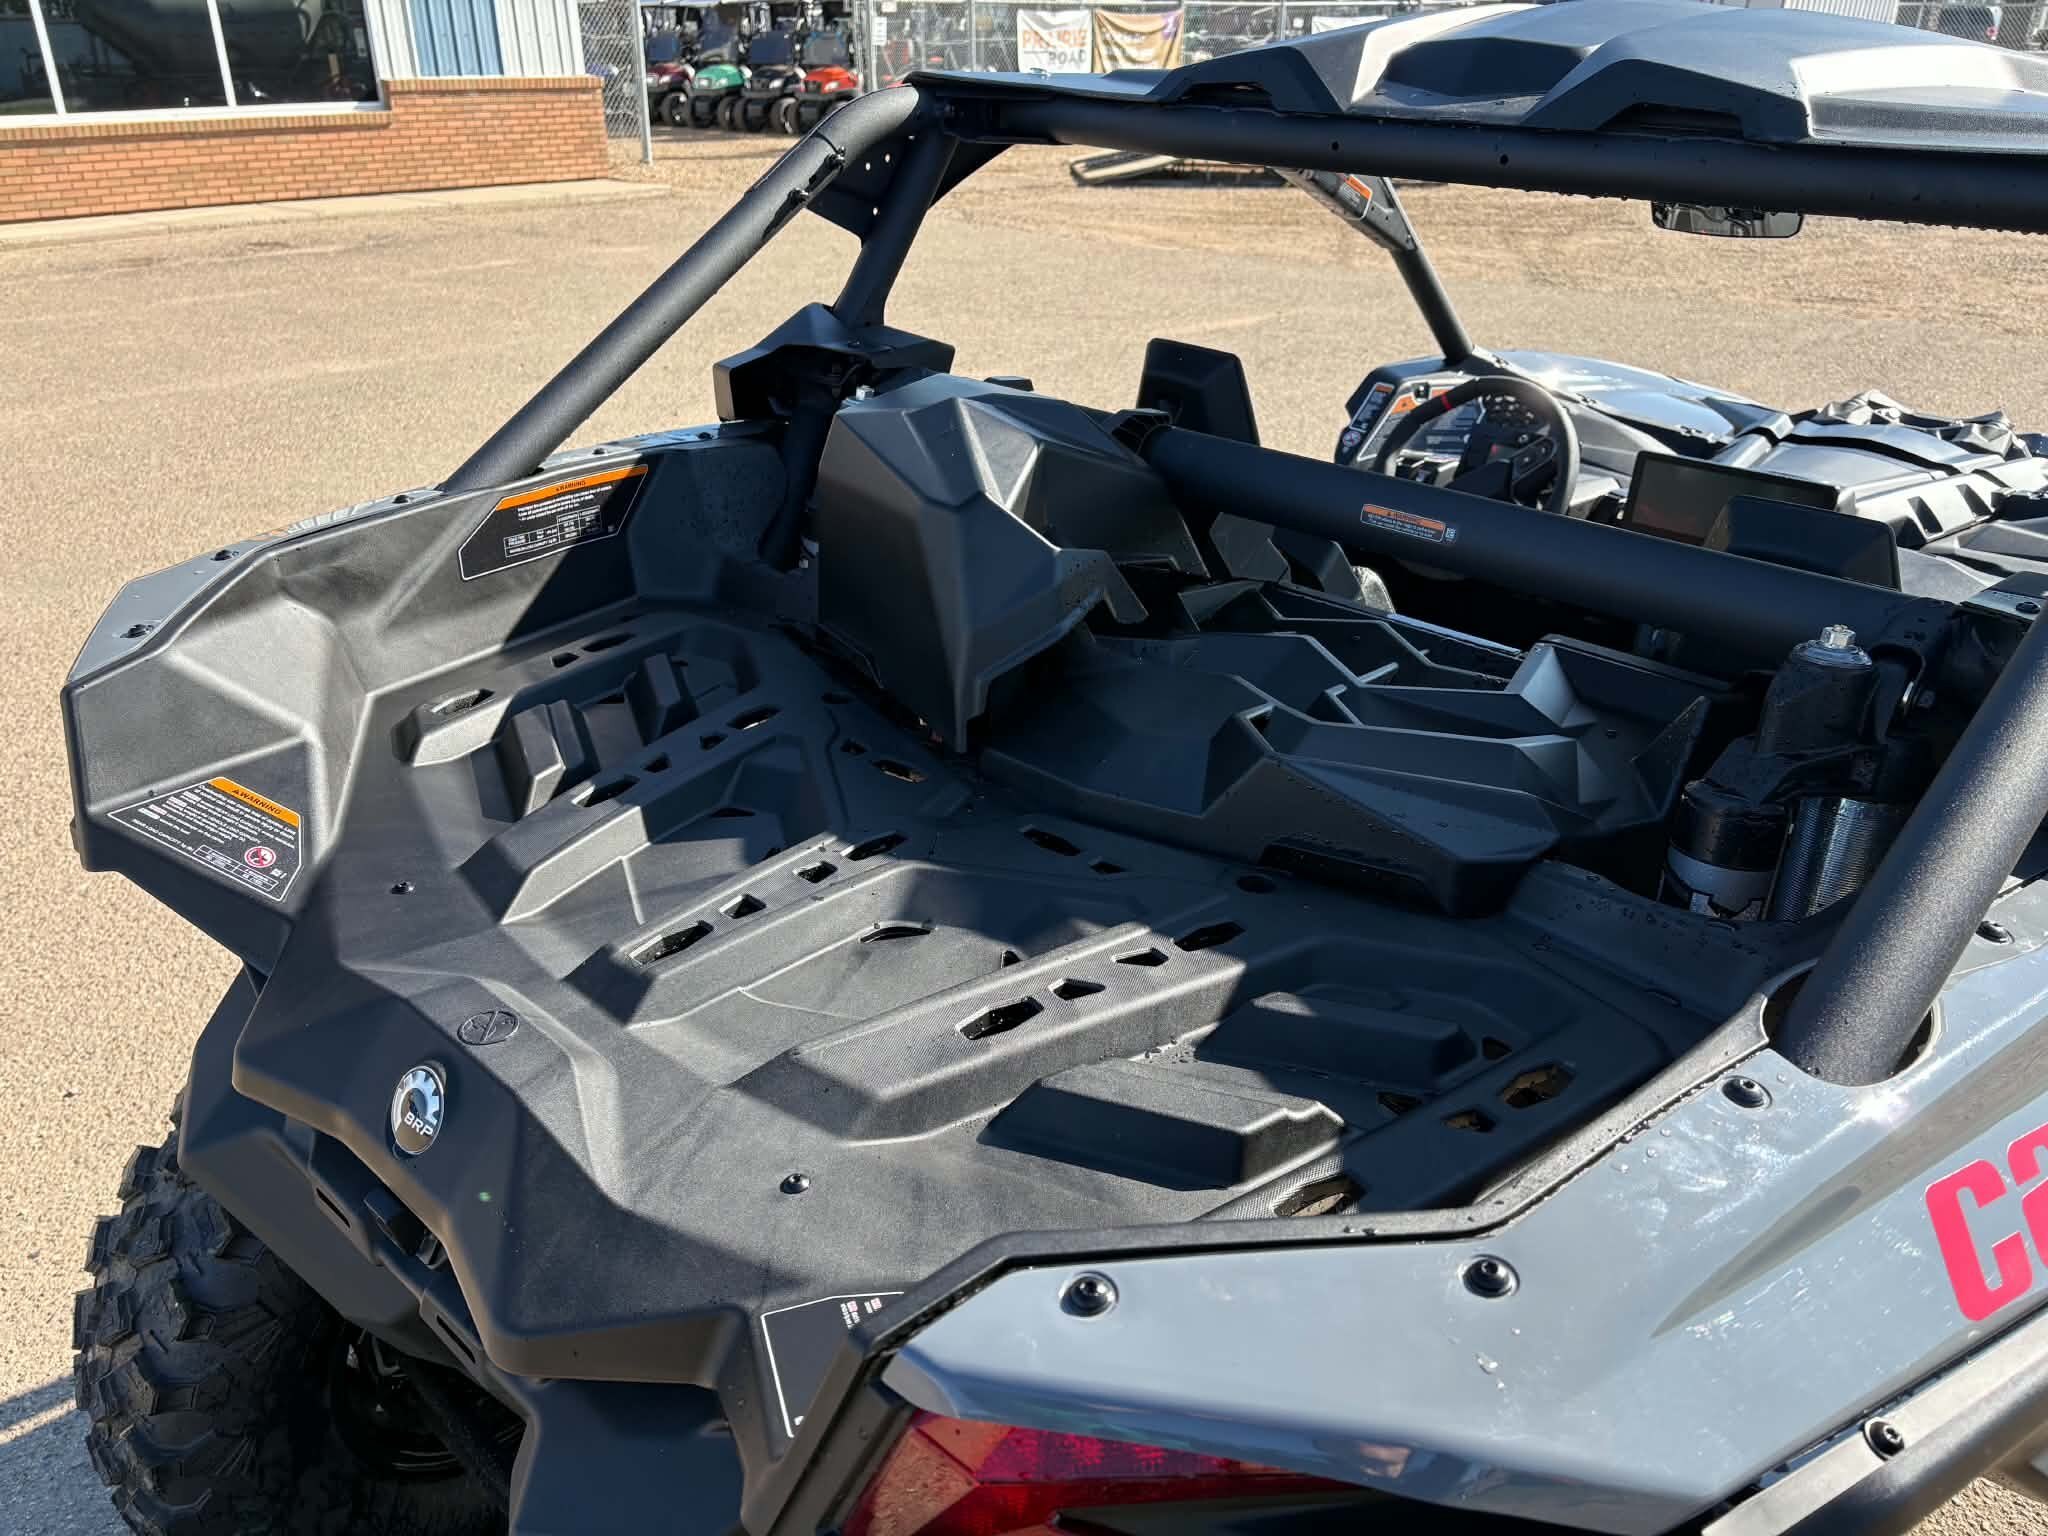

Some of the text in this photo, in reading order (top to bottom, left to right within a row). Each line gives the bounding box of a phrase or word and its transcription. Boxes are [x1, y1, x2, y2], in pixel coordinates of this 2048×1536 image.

[1048, 49, 1087, 65] ROAD
[238, 790, 282, 815] WARNING
[404, 1111, 434, 1137] BRP
